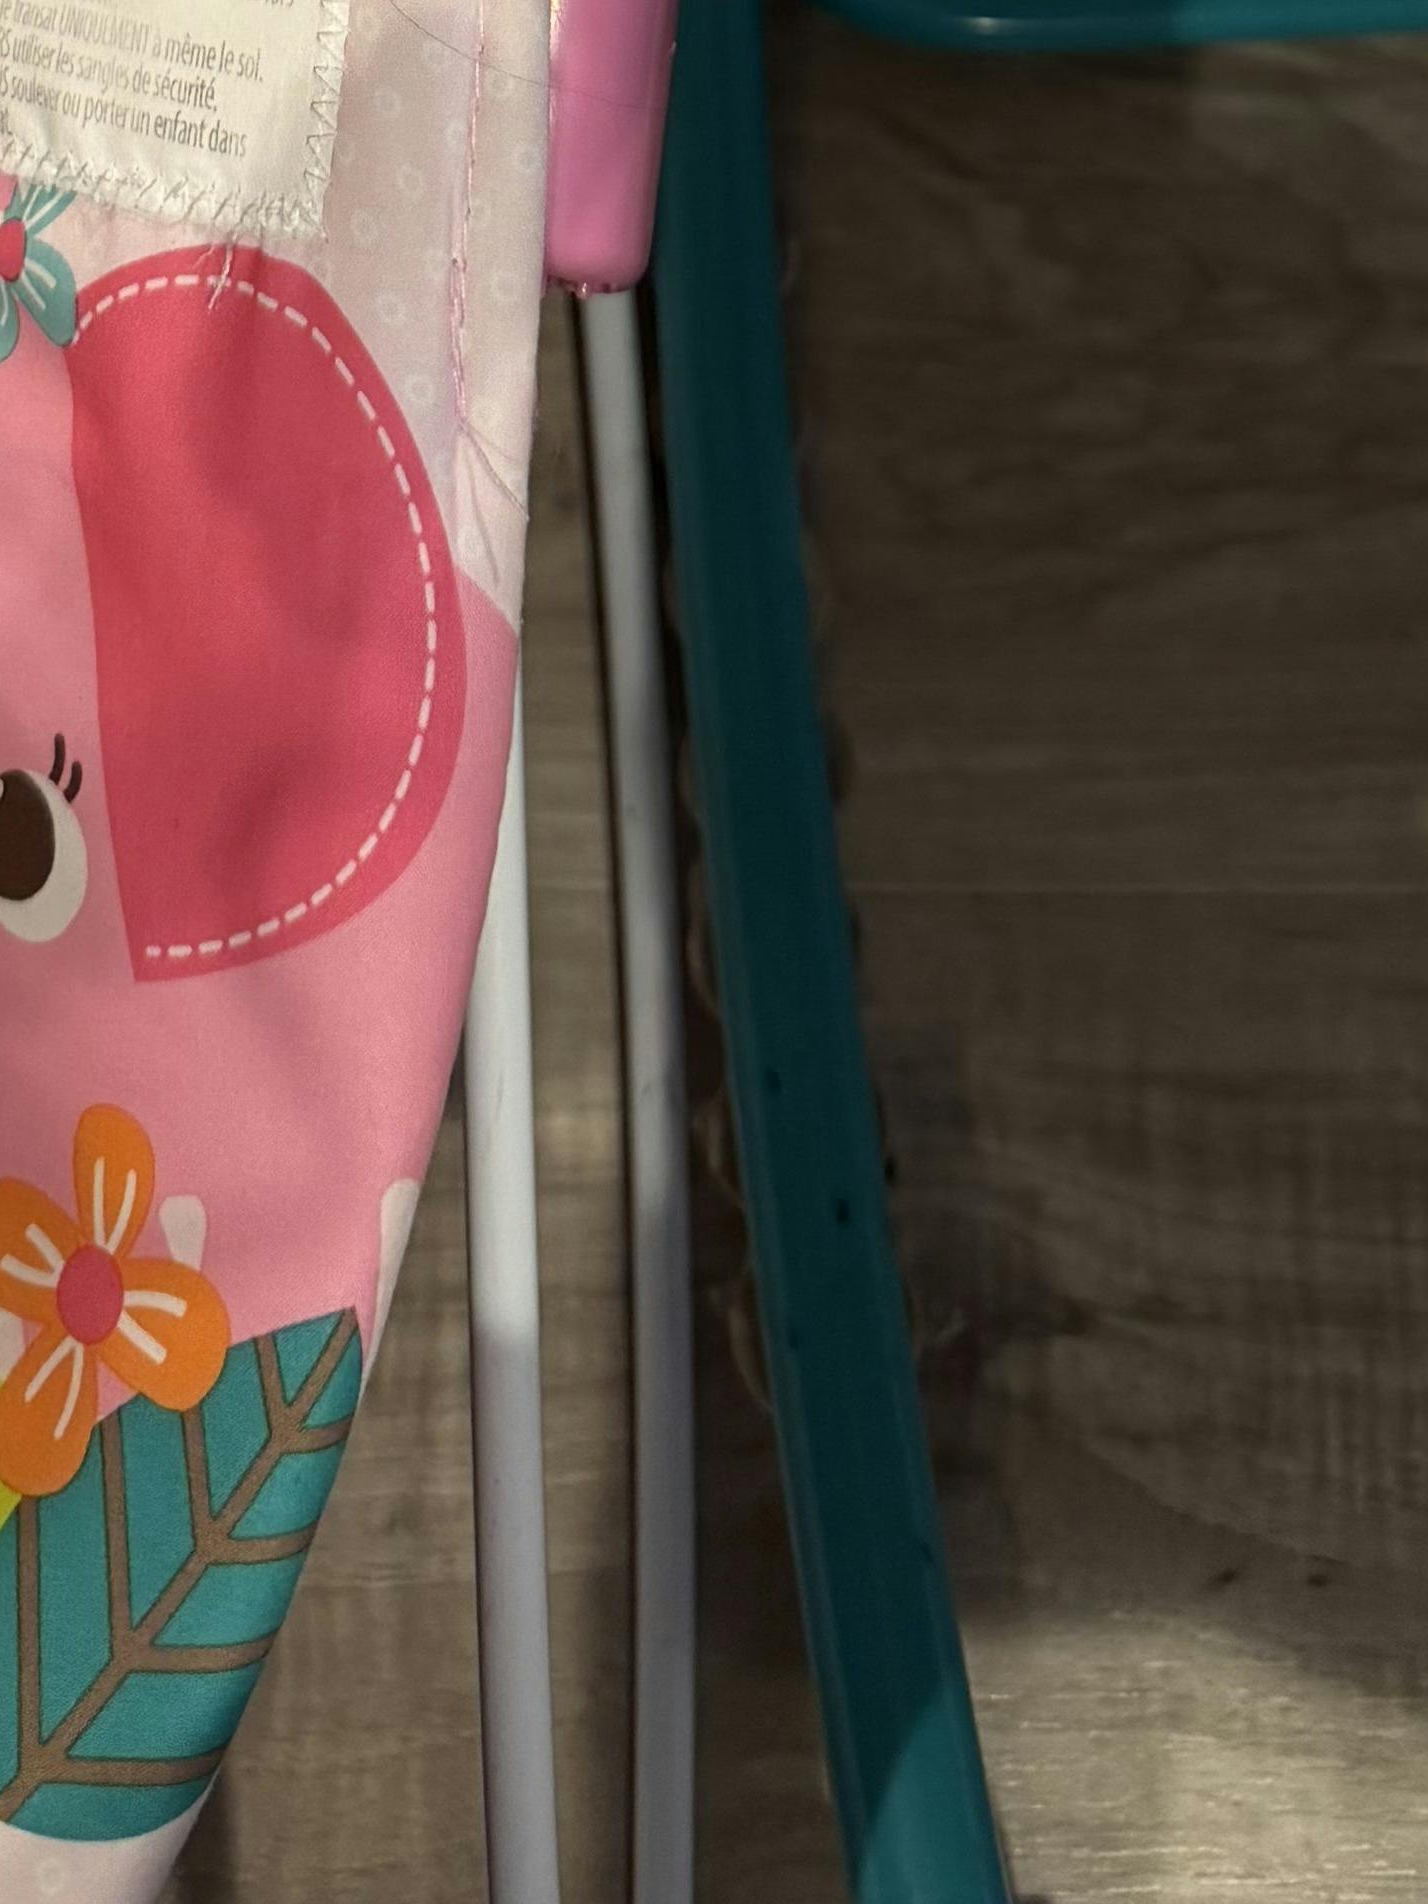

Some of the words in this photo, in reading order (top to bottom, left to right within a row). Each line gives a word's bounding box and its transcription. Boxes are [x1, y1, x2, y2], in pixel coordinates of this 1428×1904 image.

[12, 33, 56, 70] utiliser
[56, 43, 75, 77] les
[76, 55, 130, 94] sangles
[132, 64, 151, 96] de
[152, 67, 218, 113] sécurité.
[60, 3, 149, 54] UNIQUEMENT
[152, 33, 163, 58] à
[165, 32, 217, 70] même
[218, 39, 235, 74] le
[237, 48, 263, 83] sol.
[10, 74, 60, 111] soulever
[62, 91, 81, 118] ou
[82, 95, 130, 129] porter
[130, 108, 151, 136] un
[153, 110, 206, 149] enfant
[208, 119, 249, 158] dans
